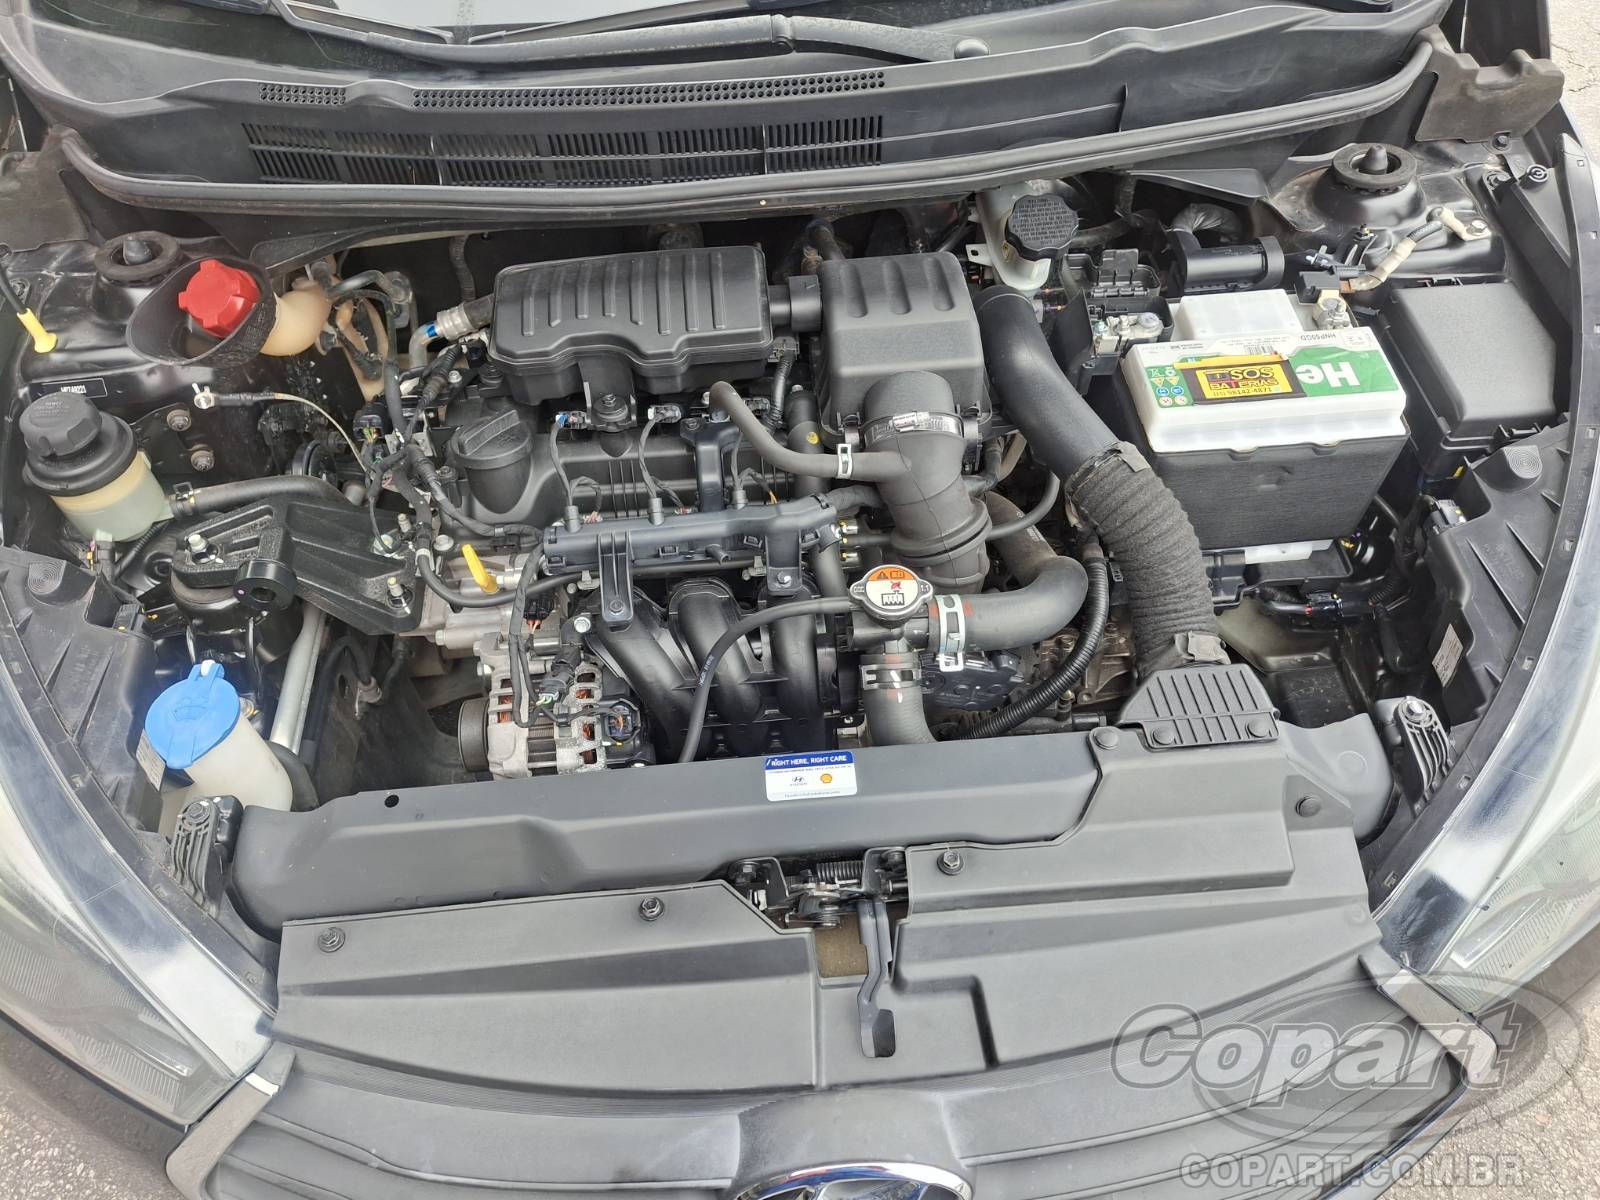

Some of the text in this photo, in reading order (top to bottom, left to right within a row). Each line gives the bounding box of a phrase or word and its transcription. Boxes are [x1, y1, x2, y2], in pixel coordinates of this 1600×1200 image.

[1230, 366, 1275, 380] SOS
[1210, 378, 1279, 391] BATERIAS
[810, 756, 829, 764] RIGHT
